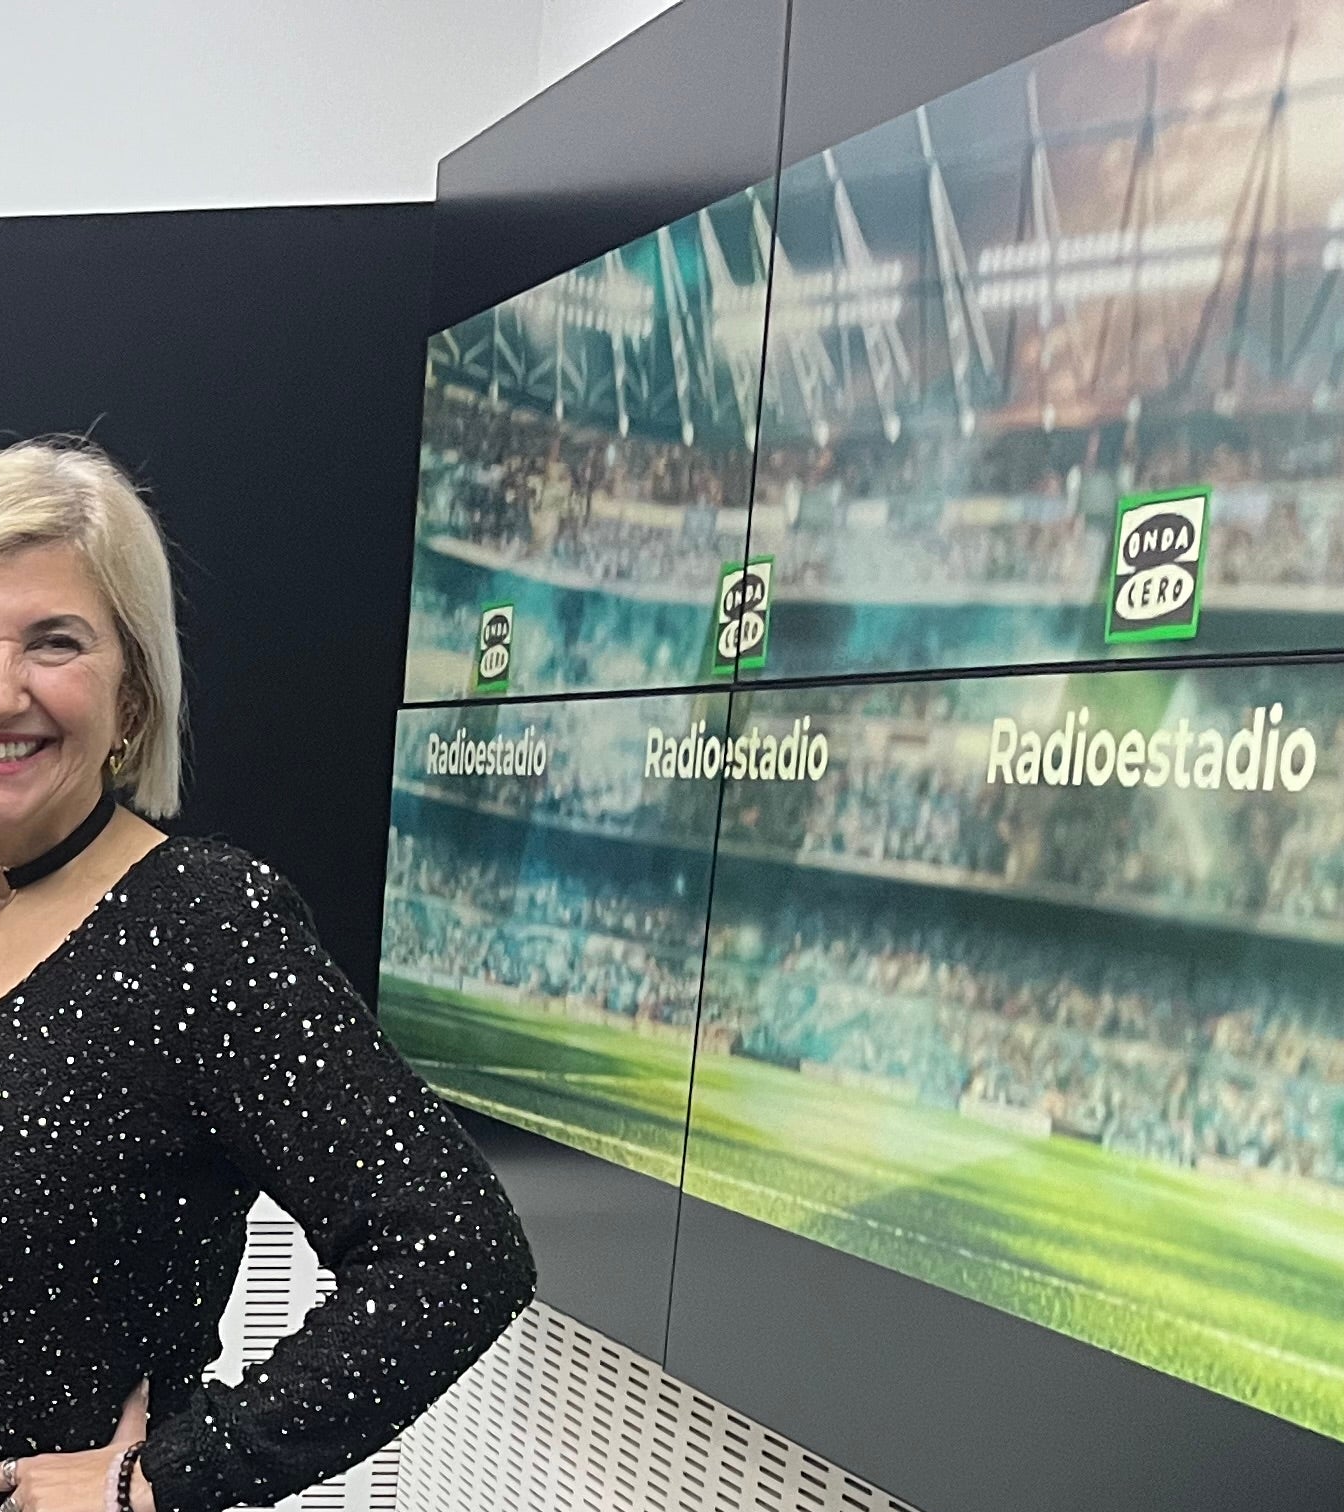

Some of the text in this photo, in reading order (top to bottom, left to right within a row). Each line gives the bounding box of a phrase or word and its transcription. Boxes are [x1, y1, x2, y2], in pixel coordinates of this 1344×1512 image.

[1128, 525, 1188, 558] ONDA
[726, 583, 763, 611] ONDA
[1127, 576, 1183, 609] CERO
[426, 724, 547, 777] Radioestadio
[644, 715, 829, 782] Radioestadio
[986, 702, 1317, 792] Radioestadio
